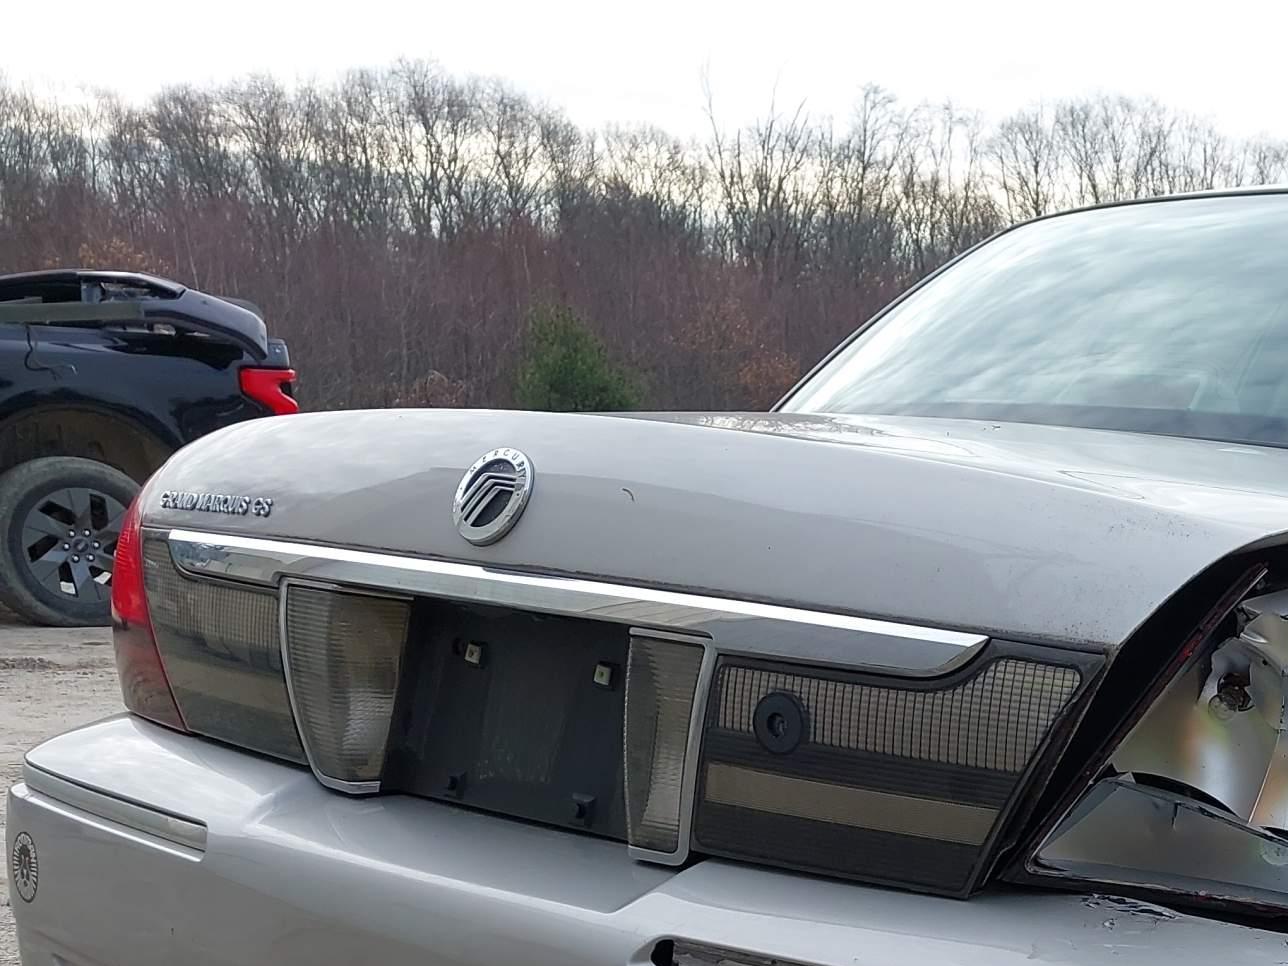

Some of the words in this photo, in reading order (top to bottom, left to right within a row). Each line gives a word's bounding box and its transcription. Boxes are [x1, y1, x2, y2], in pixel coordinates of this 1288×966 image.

[469, 448, 527, 479] MERCURY
[160, 490, 197, 511] GRAND
[196, 492, 251, 516] MARQUIS
